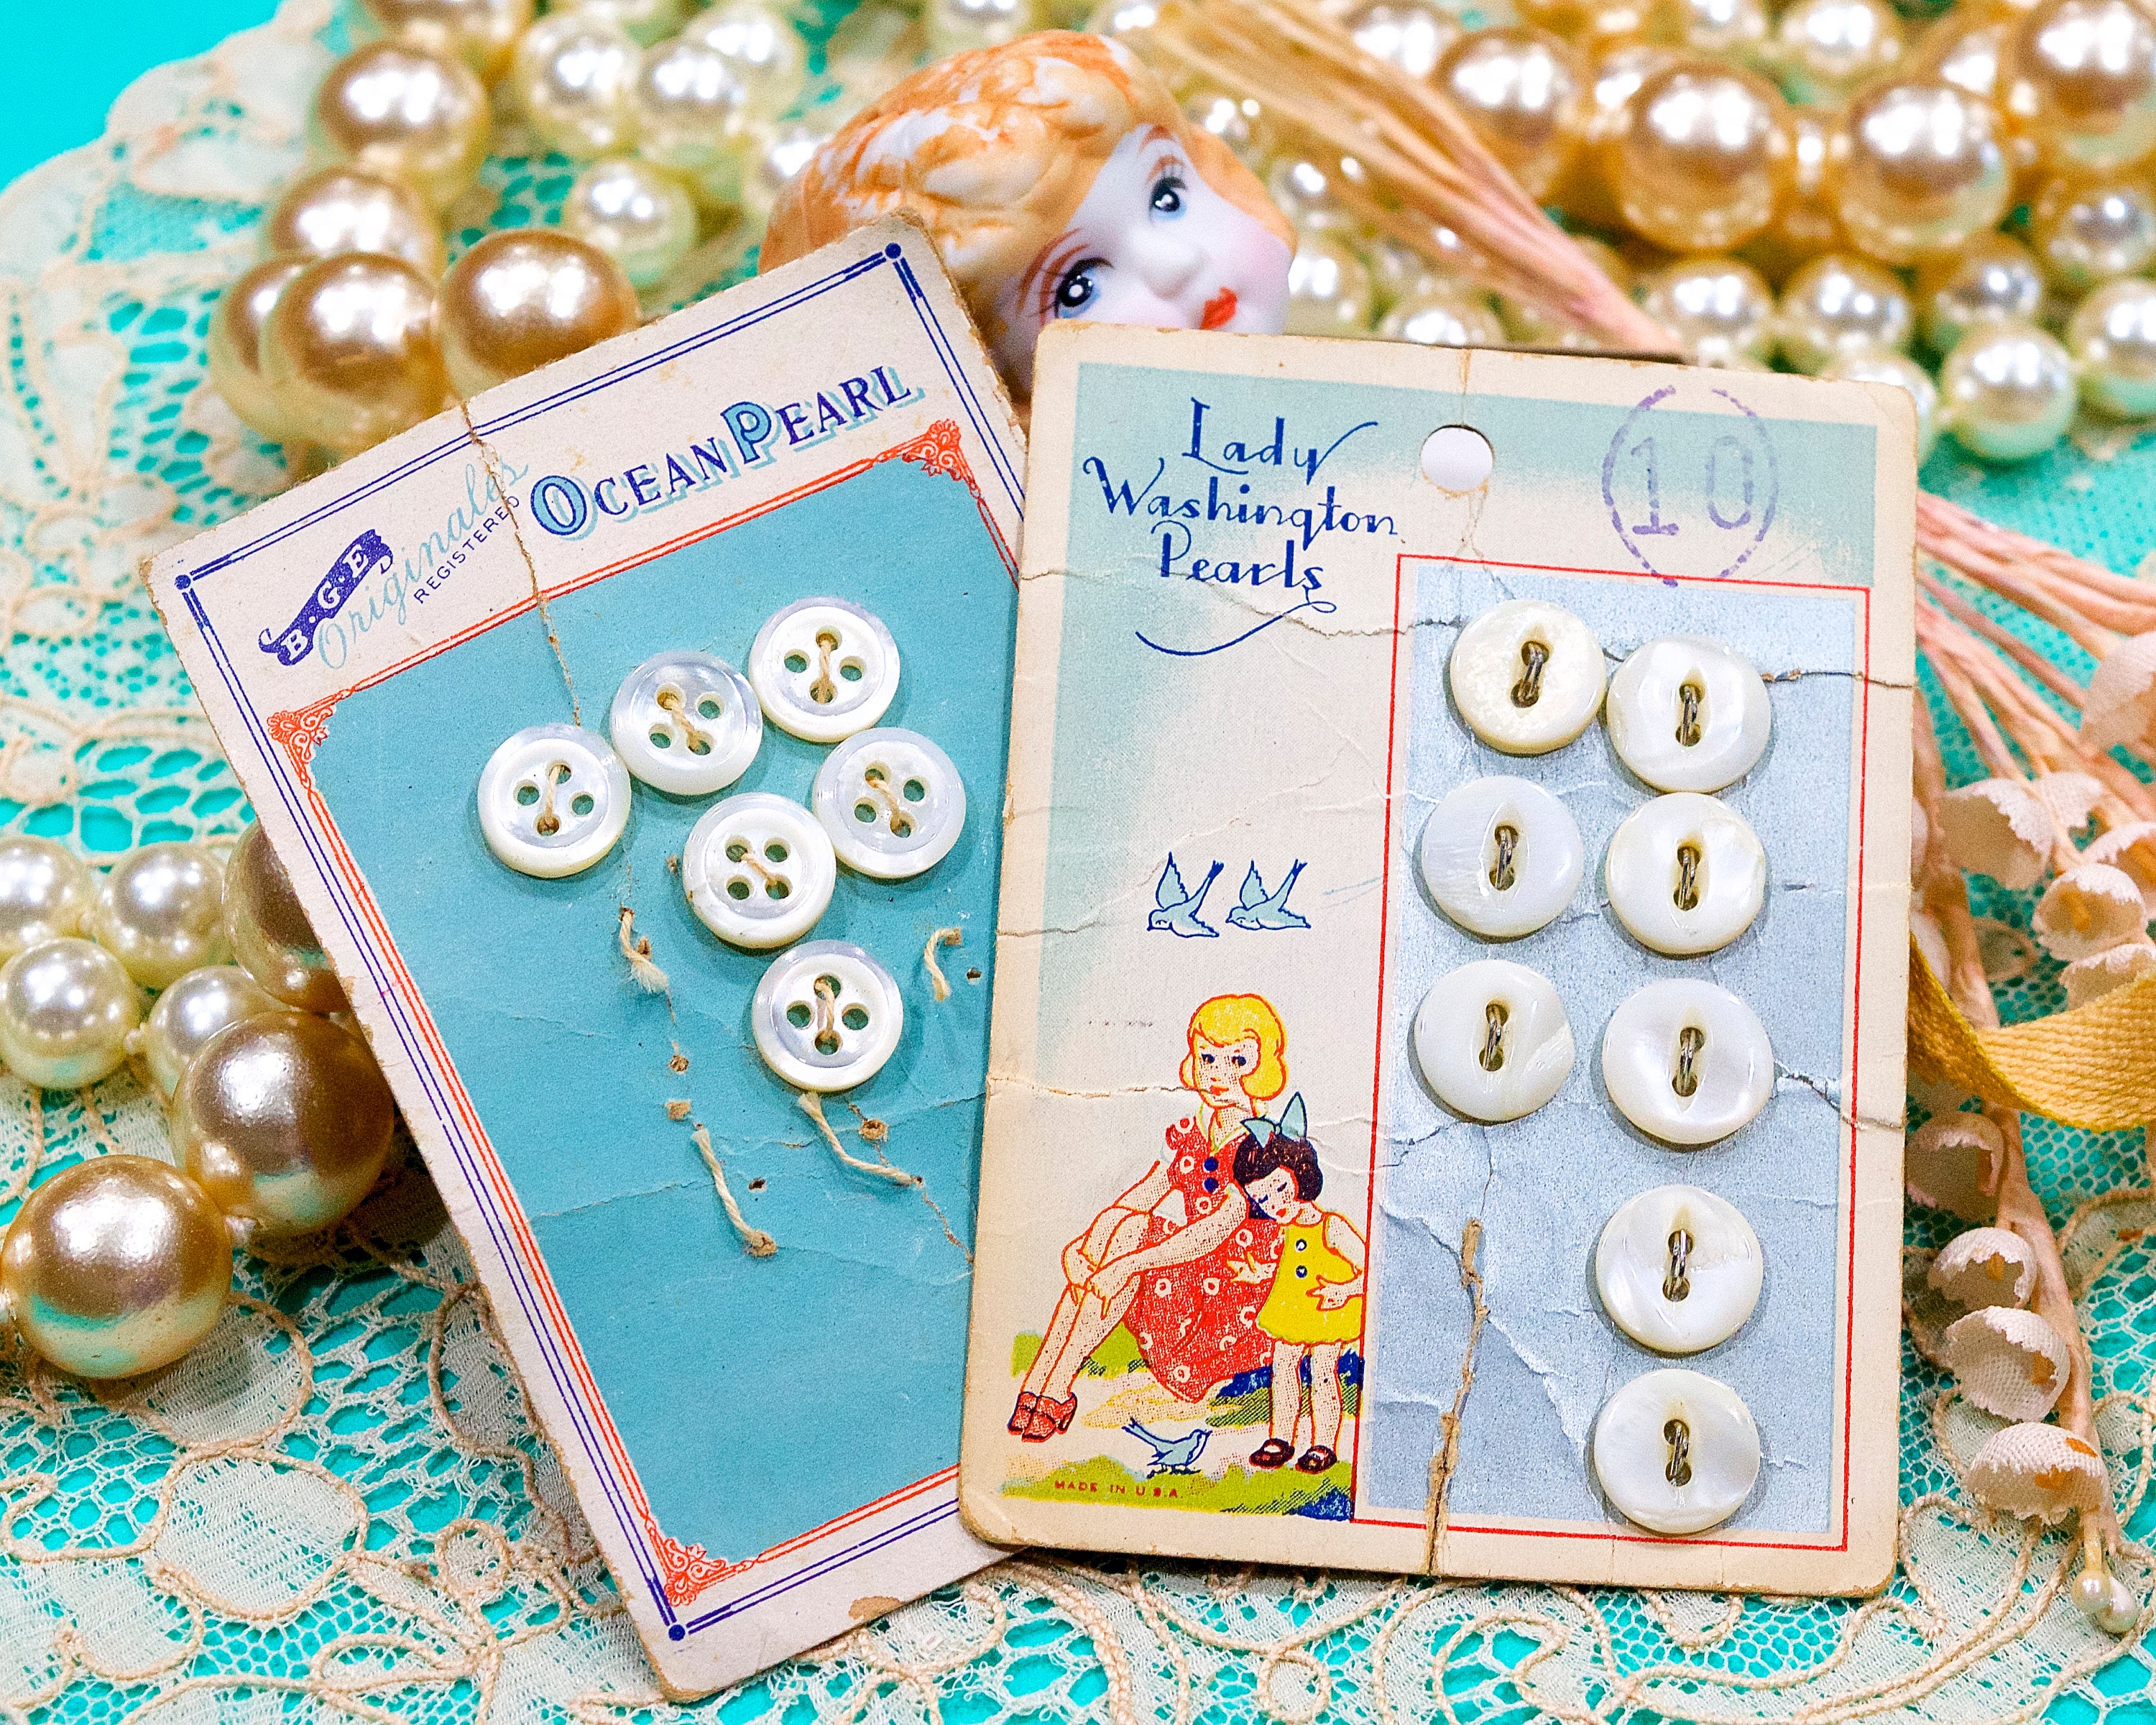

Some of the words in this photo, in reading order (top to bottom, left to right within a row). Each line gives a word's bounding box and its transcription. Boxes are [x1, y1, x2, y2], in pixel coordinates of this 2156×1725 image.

[530, 437, 736, 539] OCEAN
[720, 366, 920, 468] PEARL
[1181, 397, 1378, 485] Lady
[413, 495, 520, 604] REGISTERED
[1083, 456, 1398, 551] Washington
[1151, 520, 1337, 613] Pearls
[1054, 1480, 1098, 1493] MADE
[1110, 1484, 1125, 1494] IN
